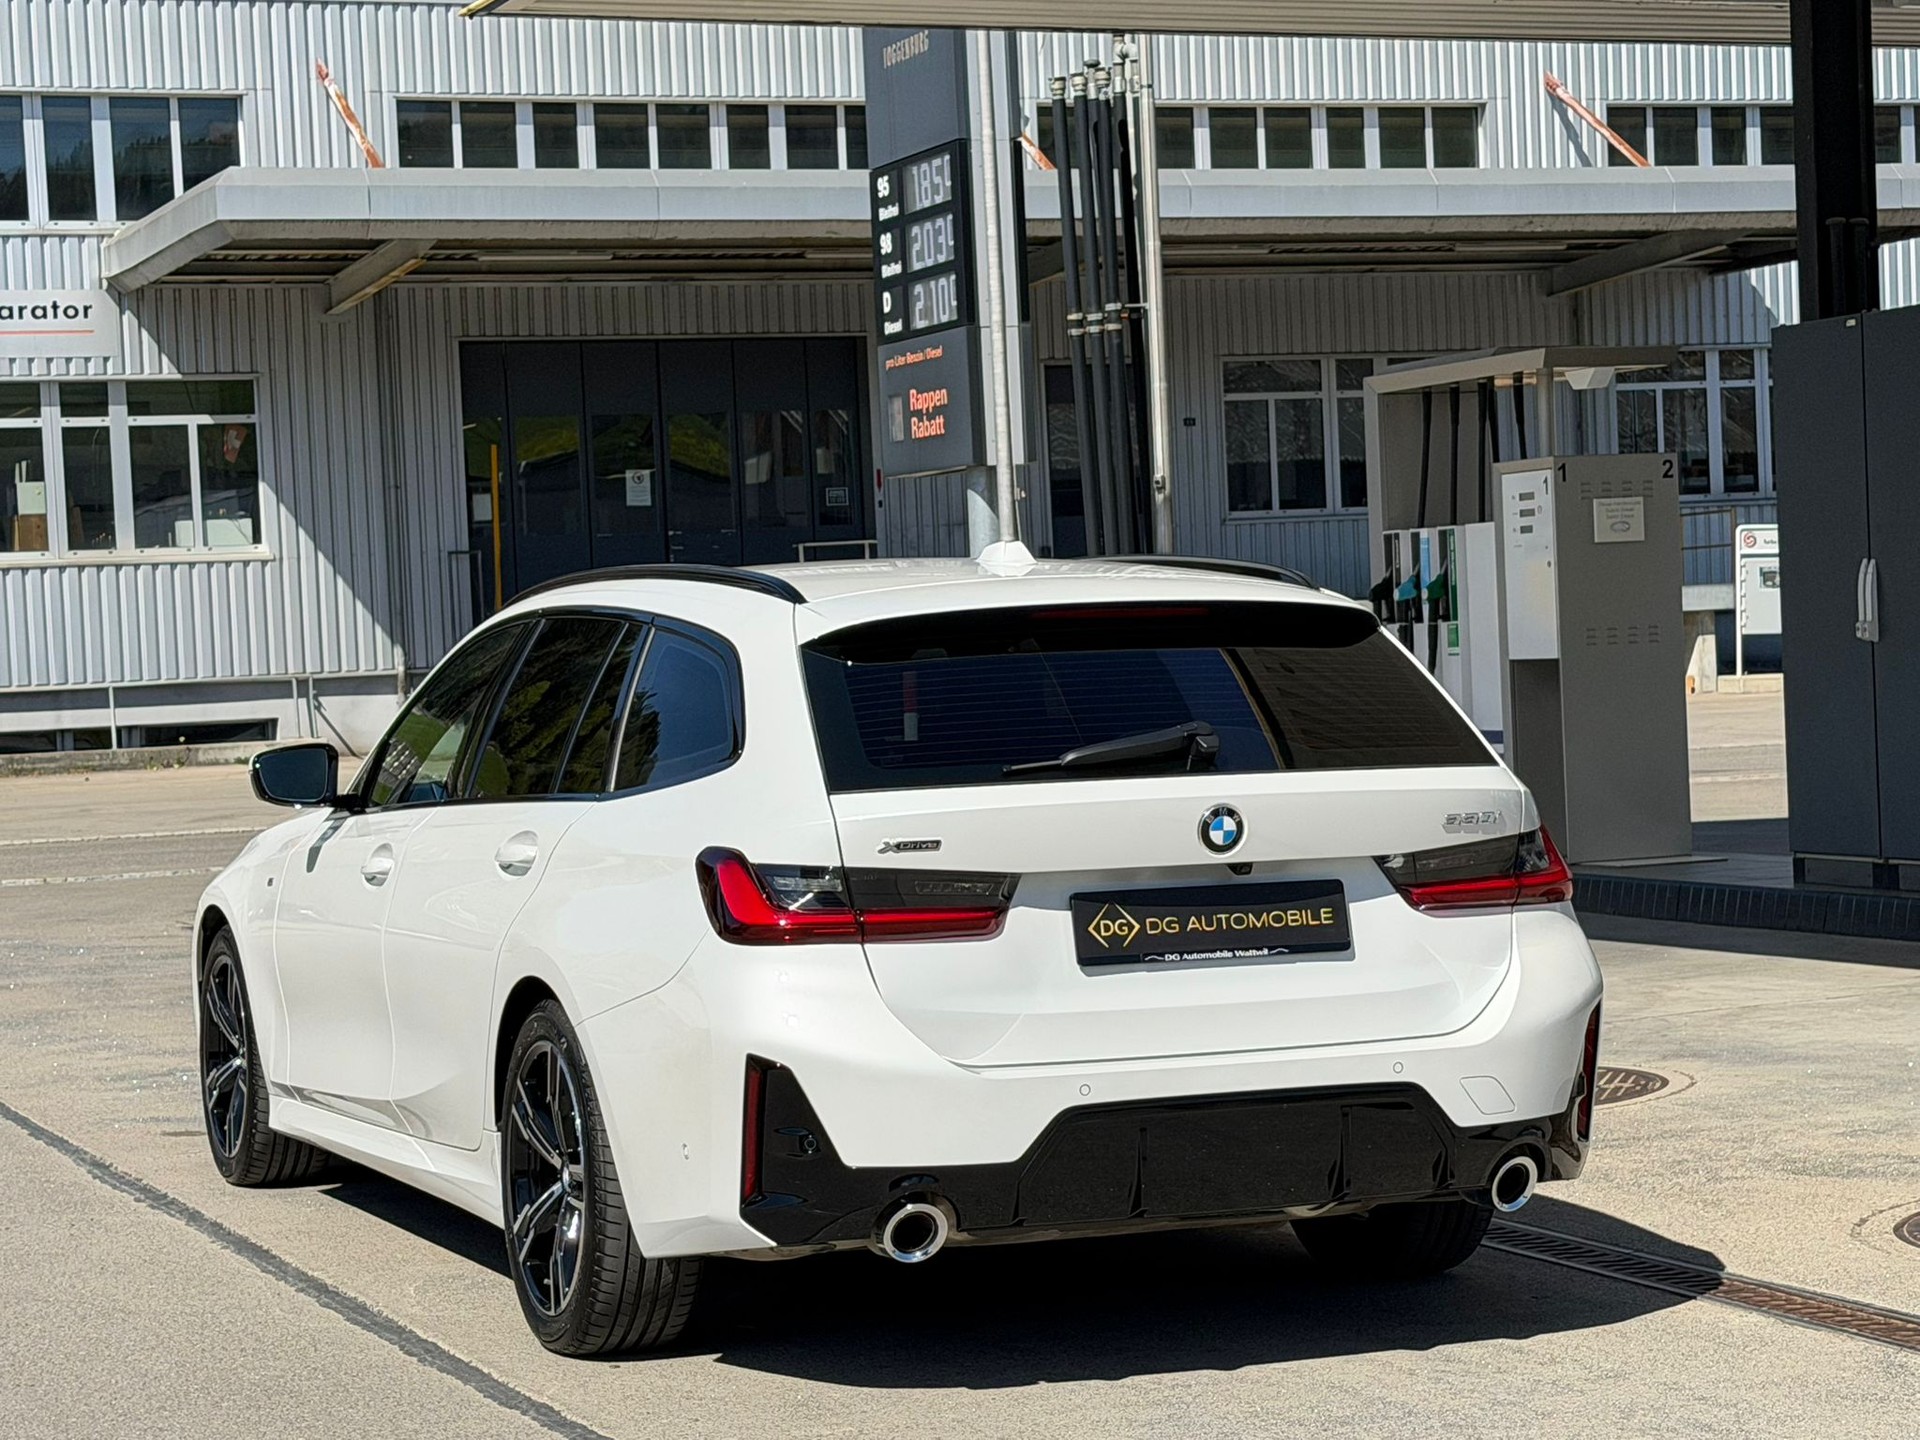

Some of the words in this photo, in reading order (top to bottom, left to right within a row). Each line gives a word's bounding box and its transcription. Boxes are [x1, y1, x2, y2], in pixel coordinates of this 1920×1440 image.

[877, 174, 890, 198] 95
[880, 232, 893, 255] 98
[0, 300, 93, 320] arator
[882, 291, 892, 314] D
[909, 388, 948, 414] Rappen
[911, 414, 945, 439] Rabatt
[1557, 463, 1567, 482] 1
[1661, 459, 1674, 479] 2
[1542, 476, 1549, 495] 1
[1100, 919, 1129, 937] DG
[1145, 917, 1180, 935] DG
[1186, 907, 1334, 932] AUTOMOBILE
[1164, 953, 1181, 961] DG
[1182, 950, 1233, 960] Automobile
